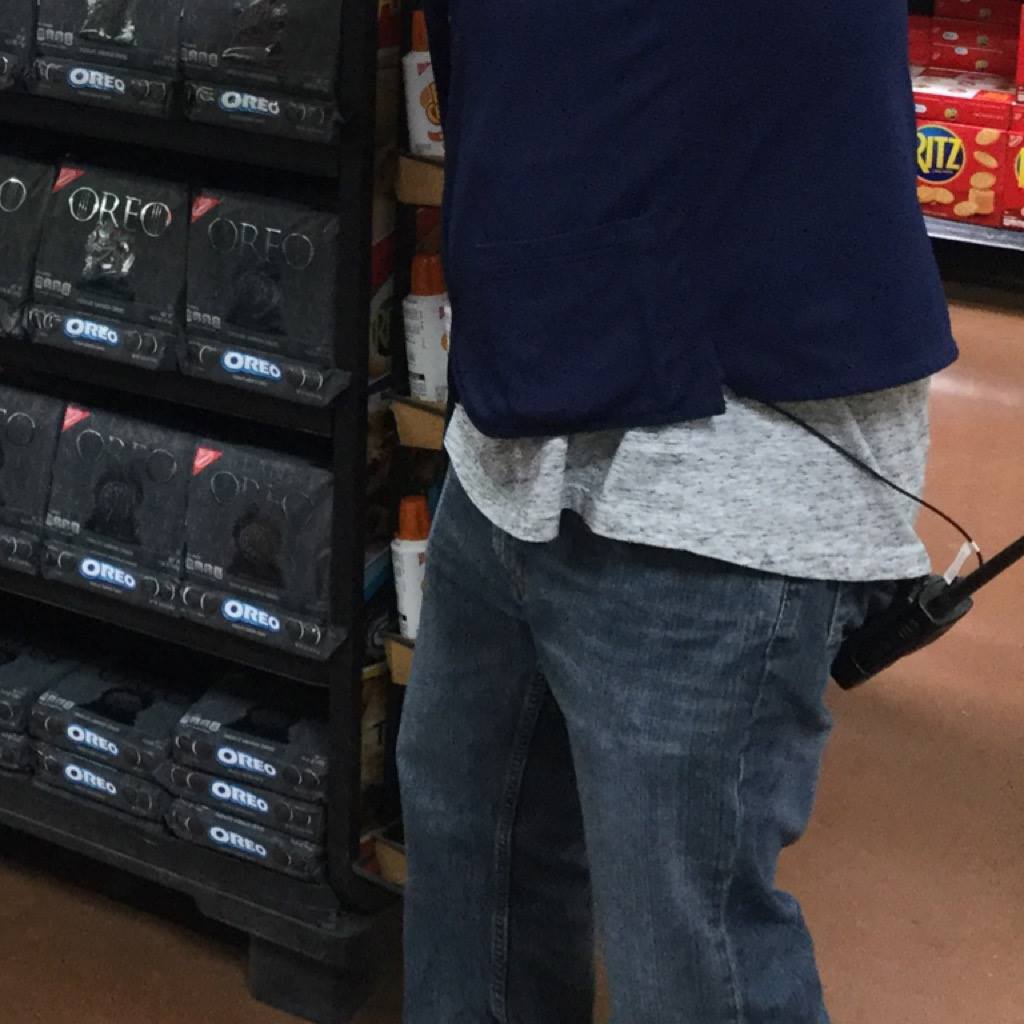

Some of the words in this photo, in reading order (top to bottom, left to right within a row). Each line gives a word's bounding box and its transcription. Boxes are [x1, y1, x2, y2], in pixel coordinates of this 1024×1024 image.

[70, 67, 125, 94] OREO
[221, 90, 280, 115] OREO
[68, 186, 173, 238] OREO
[65, 317, 118, 344] OREO
[224, 351, 282, 378] OREO
[80, 557, 136, 589] OREO
[224, 599, 281, 630] OREO
[68, 725, 119, 755] OREO
[217, 747, 276, 776] OREO
[65, 764, 117, 794] OREO
[212, 782, 269, 812] OREO
[210, 826, 267, 857] OREO
